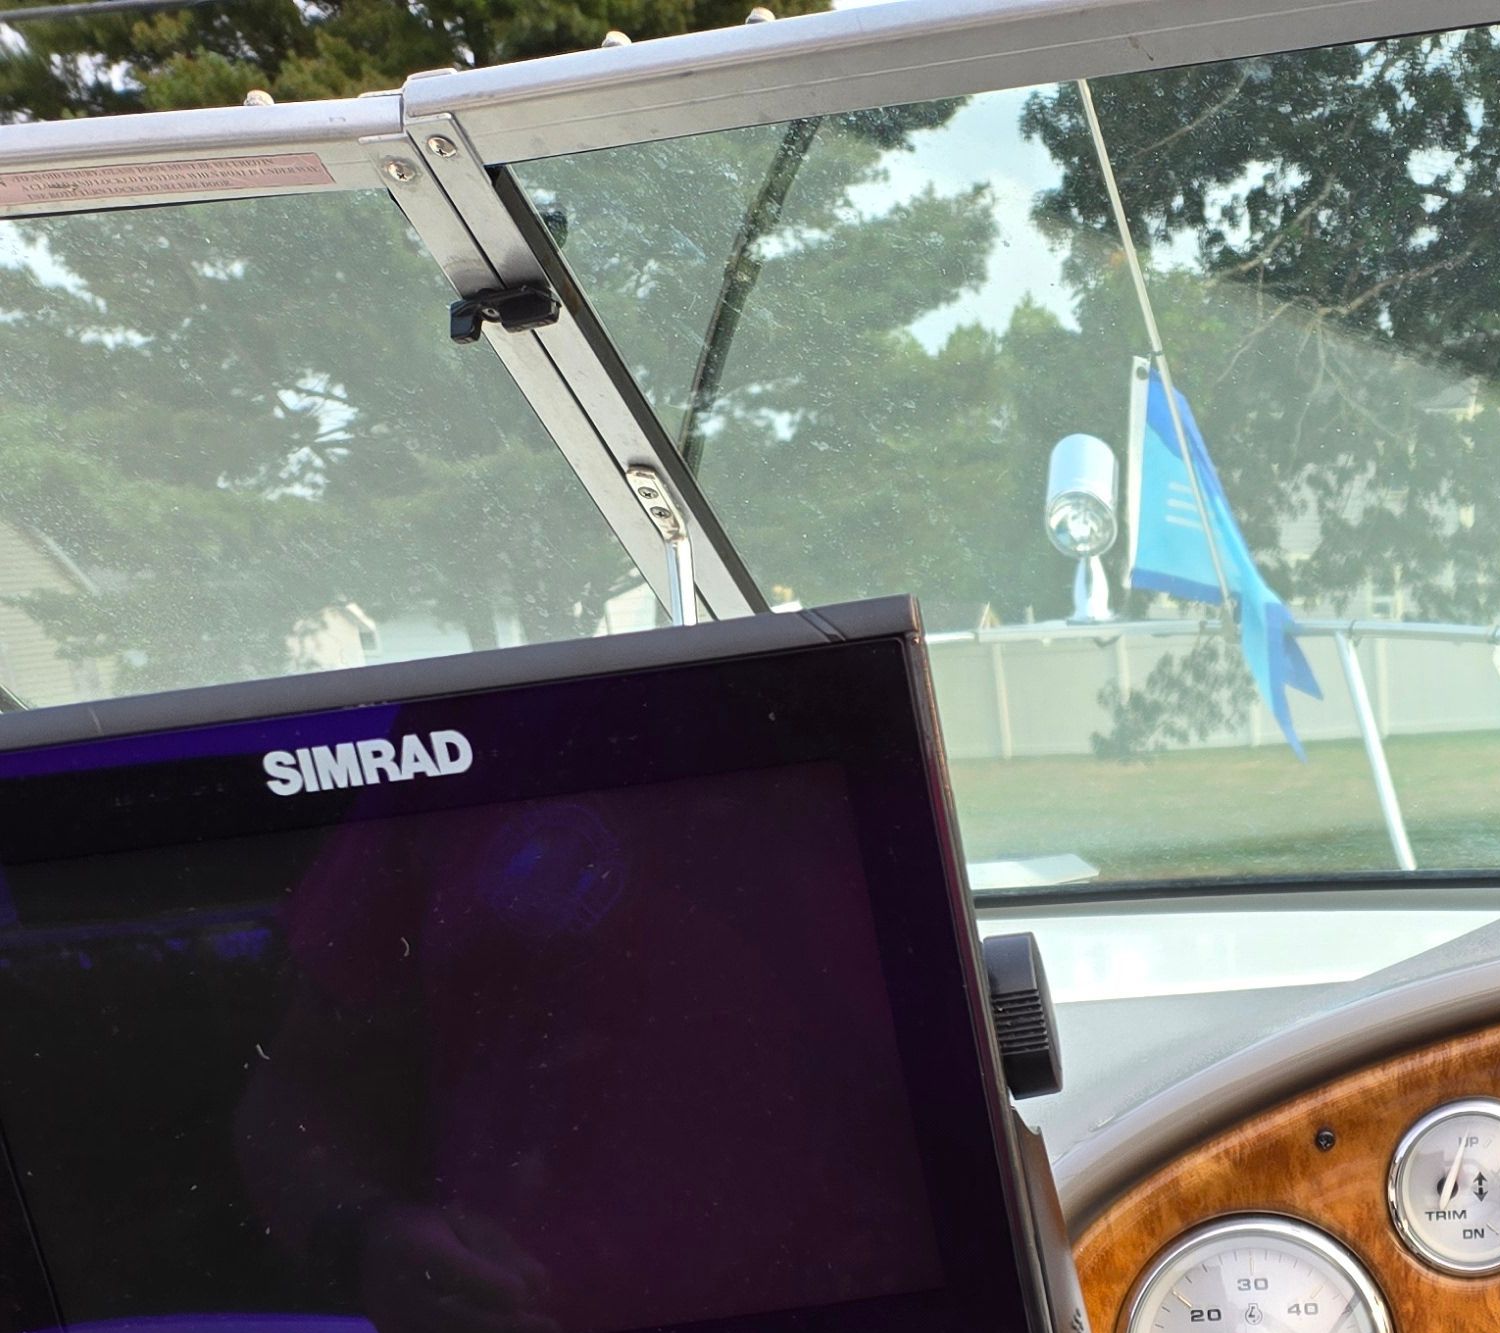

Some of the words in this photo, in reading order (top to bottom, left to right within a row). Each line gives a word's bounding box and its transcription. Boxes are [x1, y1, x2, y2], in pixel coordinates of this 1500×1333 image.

[262, 729, 473, 797] SIMRAD
[1425, 1209, 1467, 1221] TRIM
[1463, 1228, 1485, 1239] DN
[1237, 1278, 1268, 1291] 30
[1190, 1309, 1222, 1322] 20
[1288, 1303, 1318, 1316] 40
